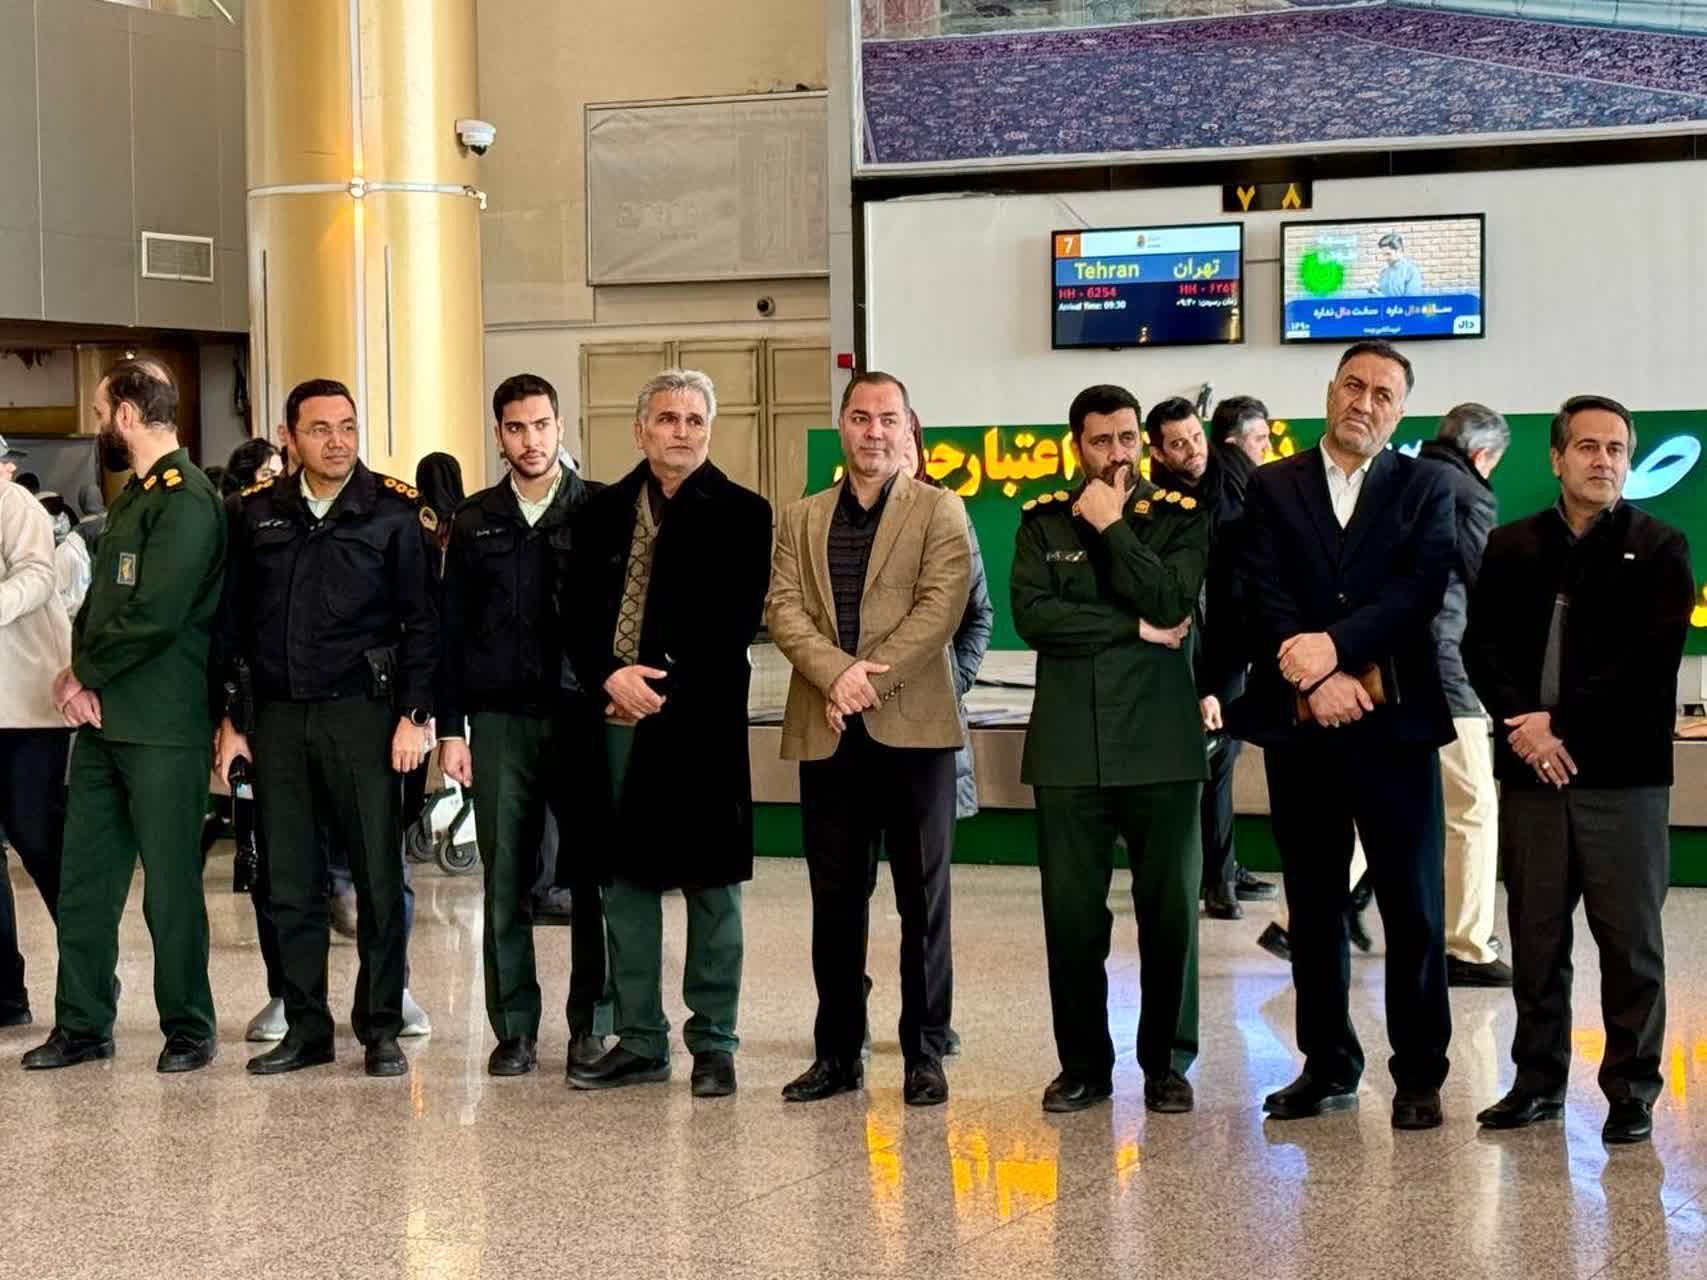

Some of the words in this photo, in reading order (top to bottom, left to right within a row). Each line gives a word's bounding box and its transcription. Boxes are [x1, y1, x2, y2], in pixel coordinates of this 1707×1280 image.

[1063, 238, 1073, 254] 7
[1073, 261, 1140, 281] Tehran
[1173, 257, 1221, 279] تهران
[1087, 285, 1117, 299] 6254
[1457, 319, 1475, 329] دال
